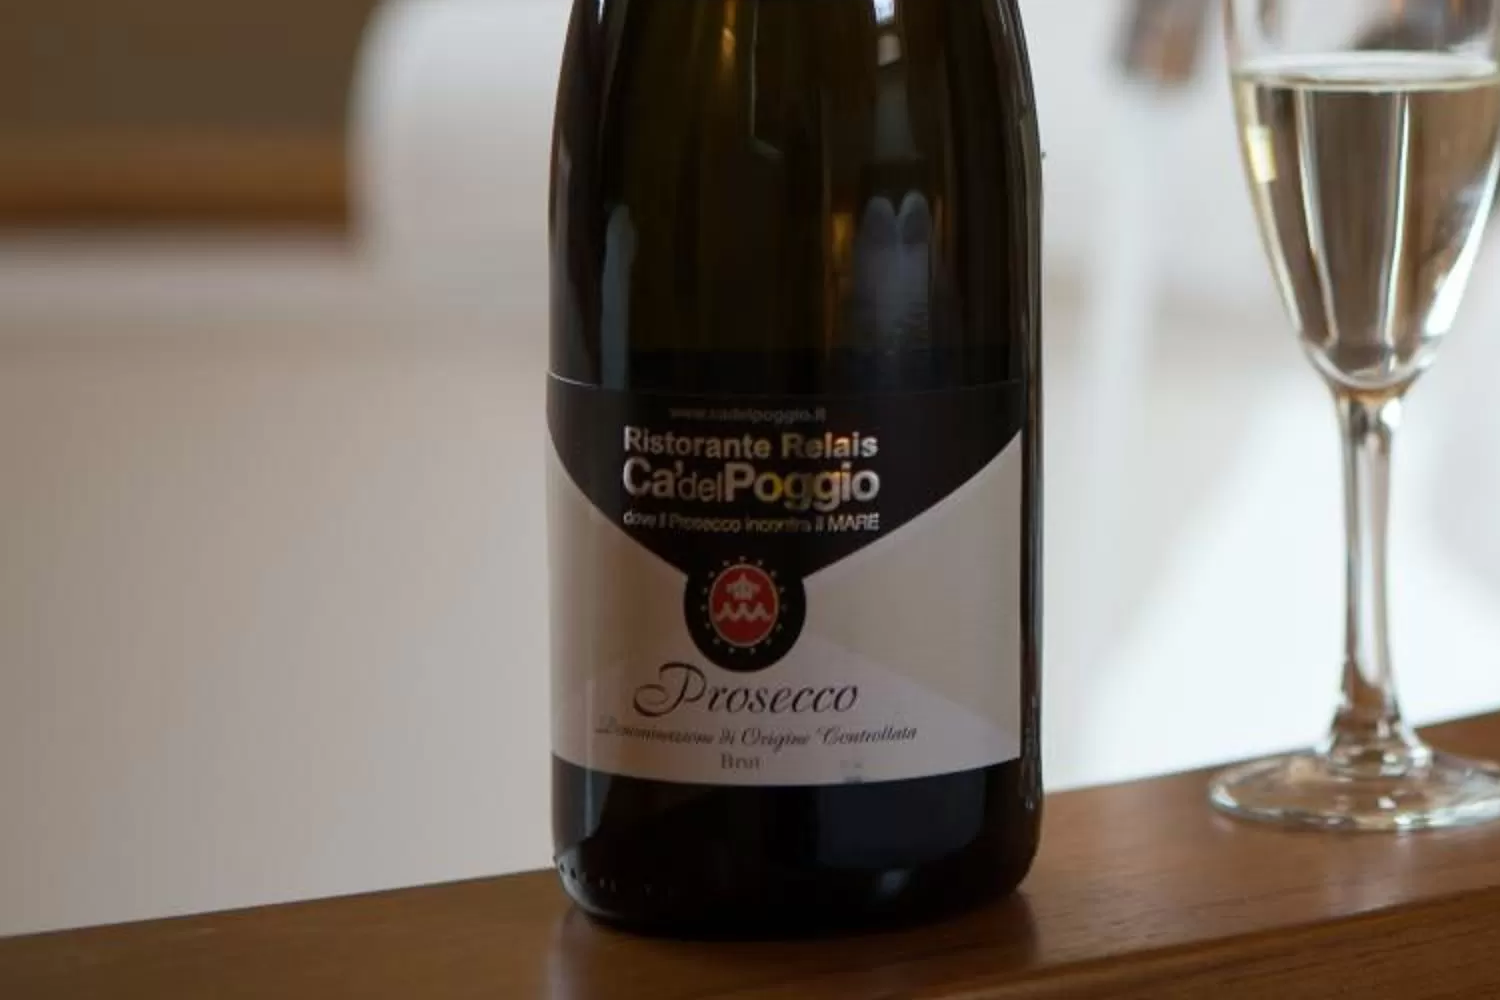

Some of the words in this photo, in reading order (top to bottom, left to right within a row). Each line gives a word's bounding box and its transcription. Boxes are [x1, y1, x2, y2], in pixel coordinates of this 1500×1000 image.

[623, 425, 773, 459] Ristorante
[780, 431, 879, 459] Relais
[622, 508, 657, 528] dove
[669, 513, 742, 533] Prosecco
[827, 511, 880, 533] MARE
[632, 661, 859, 718] Prosecco
[740, 727, 812, 755] Origine
[720, 752, 761, 770] Brut
